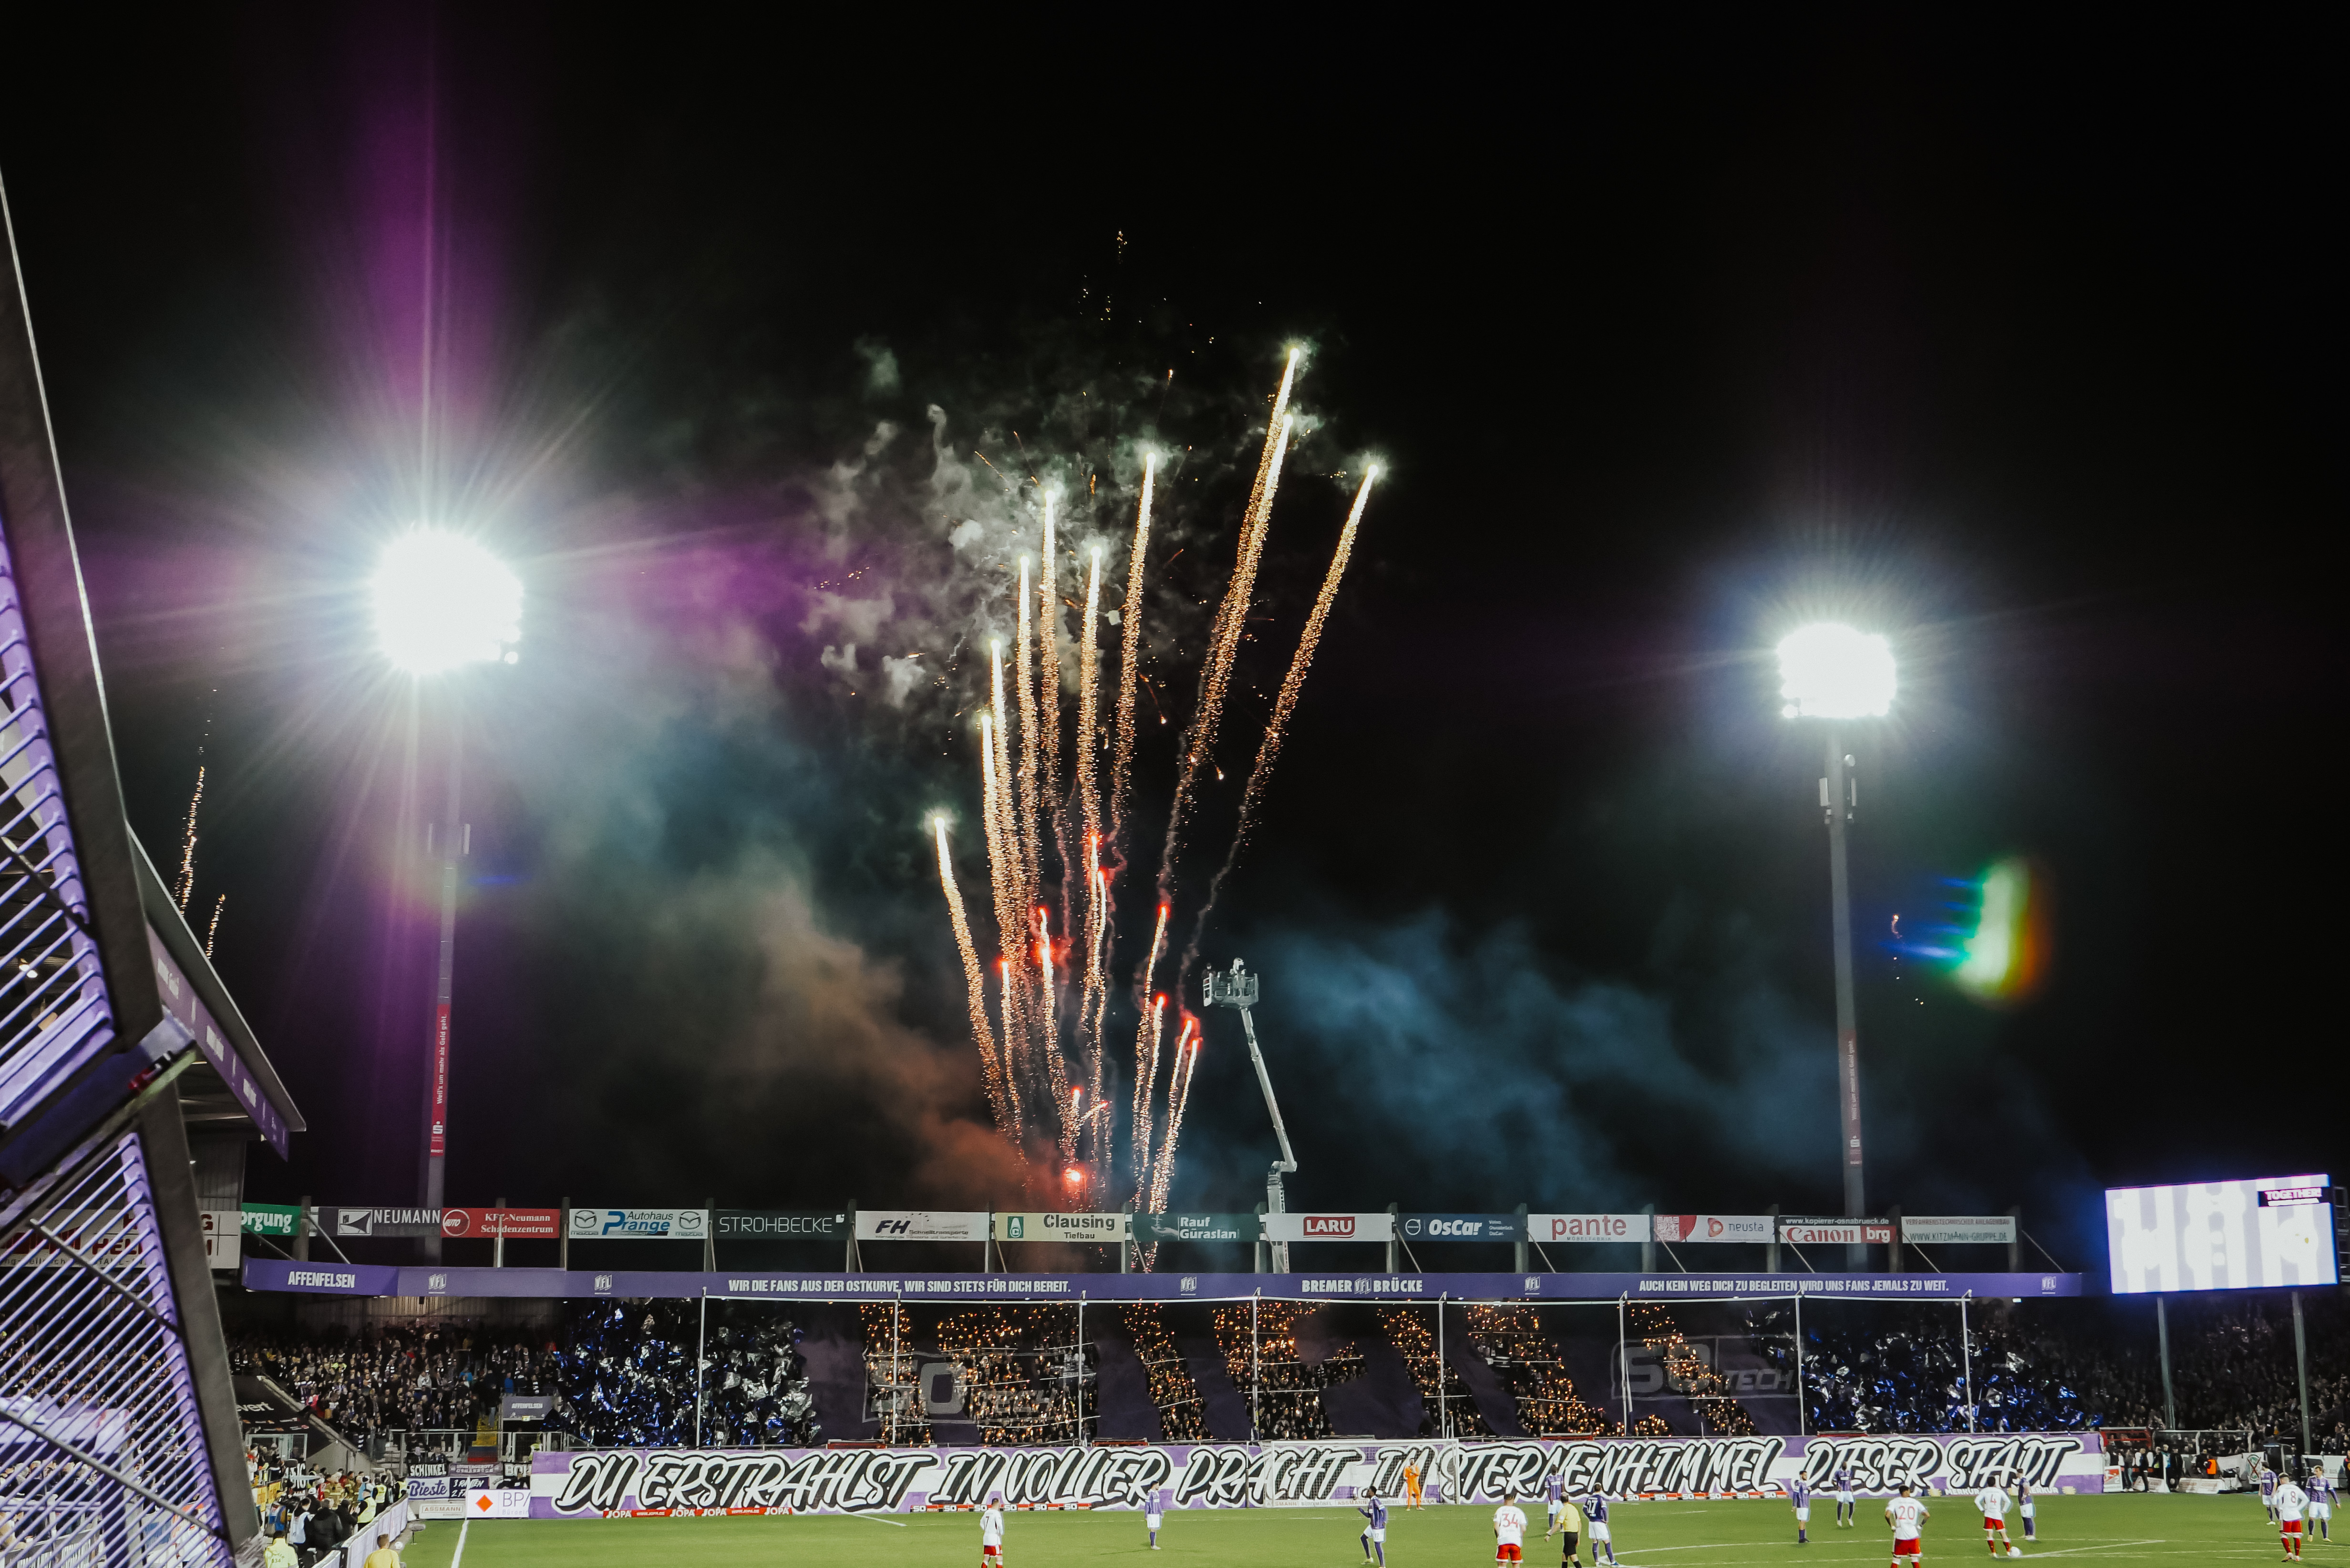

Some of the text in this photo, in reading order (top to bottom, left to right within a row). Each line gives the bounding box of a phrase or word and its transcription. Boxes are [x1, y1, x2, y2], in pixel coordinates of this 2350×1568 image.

[439, 1075, 444, 1084] um
[374, 1209, 441, 1224] NEUMANN
[627, 1211, 673, 1220] Autohaus
[1180, 1217, 1210, 1227] Rauf
[602, 1211, 670, 1235] Prange
[719, 1217, 832, 1233] STROHBECKE
[875, 1220, 911, 1234] FH
[1043, 1215, 1115, 1231] Clausing
[1307, 1219, 1352, 1233] LARU
[1552, 1216, 1626, 1240] pante
[1729, 1222, 1763, 1231] neusta
[1180, 1228, 1237, 1239] Güraslan
[1787, 1227, 1854, 1242] Canon
[1866, 1227, 1890, 1243] brg
[288, 1271, 355, 1288] AFFENFELSEN
[729, 1280, 750, 1292] WIR
[752, 1280, 768, 1292] DIE
[771, 1280, 798, 1292] FANS
[801, 1280, 821, 1292] AUS
[824, 1280, 844, 1292] DER
[905, 1280, 925, 1292] WIR
[927, 1280, 951, 1292] SIND
[953, 1280, 985, 1292] STETS
[987, 1279, 1006, 1292] FÜR
[1009, 1280, 1030, 1292] DICH
[1033, 1280, 1071, 1292] BEREIT.
[1302, 1280, 1352, 1292] BREMER
[1373, 1277, 1422, 1292] BRÜCKE
[1639, 1280, 1949, 1291] AUCH KEIN WEG DICH ZU BEGLEITEN WIRD UNS FANS JEMALS ZU WEIT.
[410, 1463, 446, 1477] SCHINKEL
[554, 1452, 642, 1511] DU
[640, 1451, 938, 1512] ERSTRAHLST
[931, 1451, 1005, 1505] IN
[1005, 1448, 1171, 1506] VOLLER
[1176, 1448, 1364, 1507] PRACHT
[1794, 1438, 1943, 1495] DIESER
[1946, 1438, 2080, 1490] STADT
[408, 1480, 447, 1497] Bieste
[1990, 1495, 1996, 1504] 4
[2291, 1491, 2296, 1503] 8
[1587, 1500, 1598, 1514] 27
[1898, 1506, 1915, 1519] 20
[986, 1516, 989, 1527] 7
[1502, 1513, 1518, 1527] 34
